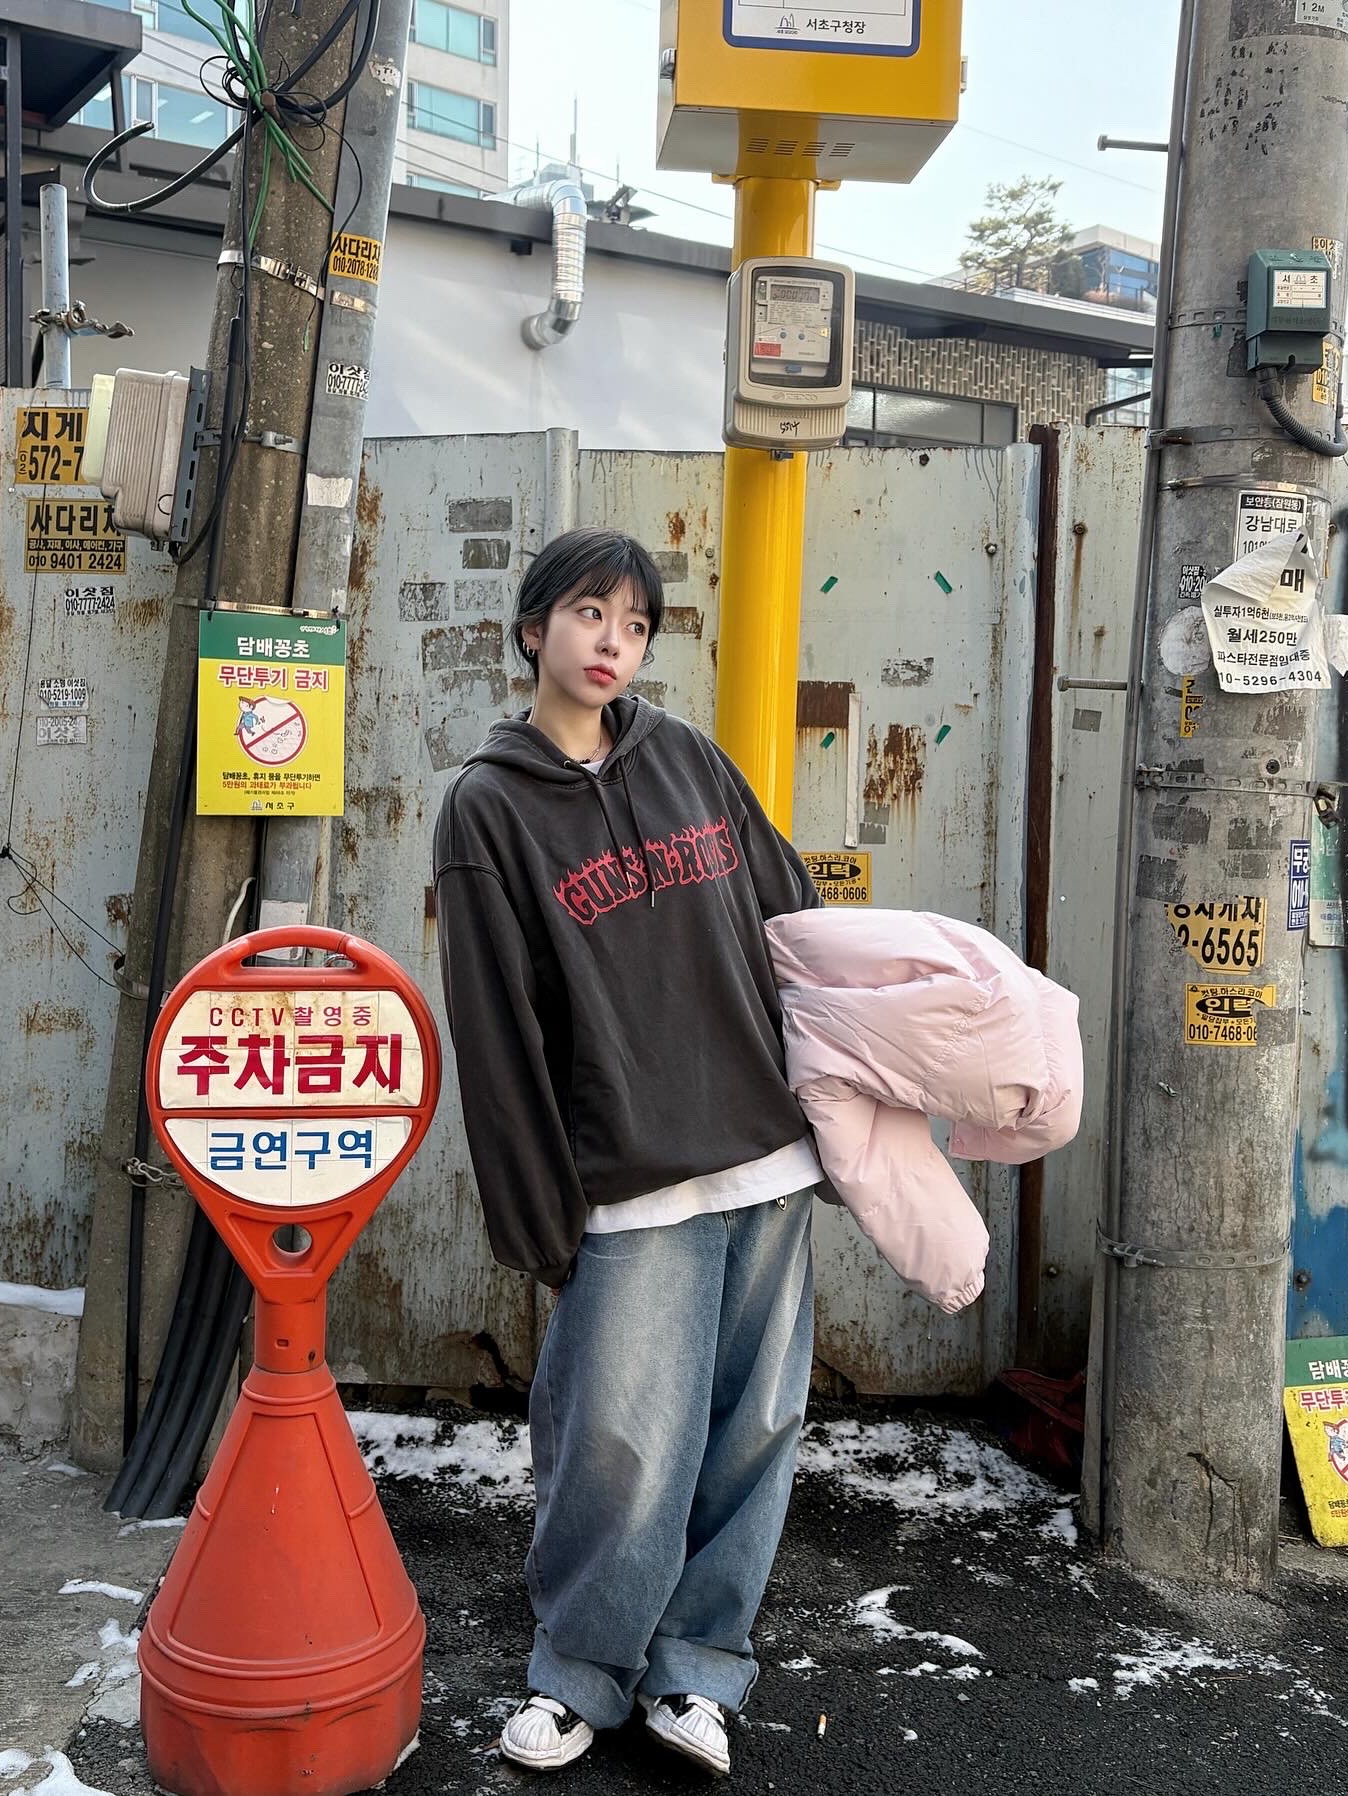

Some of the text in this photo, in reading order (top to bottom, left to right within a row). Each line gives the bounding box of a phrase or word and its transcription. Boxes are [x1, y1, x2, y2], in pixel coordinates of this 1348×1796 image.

[806, 18, 867, 34] 서초구청장
[21, 411, 83, 441] 지게
[1245, 516, 1298, 533] 강남대로
[29, 553, 122, 570] 010 9401 2424
[65, 586, 114, 598] 이삿짐
[65, 596, 115, 611] 010-7777-2424
[237, 636, 310, 659] 담배꽁초
[1227, 628, 1298, 647] 월세250만
[1217, 649, 1310, 667] 파스타전문점임대중
[218, 665, 329, 691] 무단투기 금지
[807, 863, 851, 878] 인력
[553, 848, 649, 925] GUNS
[294, 1005, 373, 1027] 촬영중
[177, 1033, 403, 1096] 주차금지
[208, 1129, 373, 1171] 금연구역
[1300, 1389, 1348, 1412] 무단투
